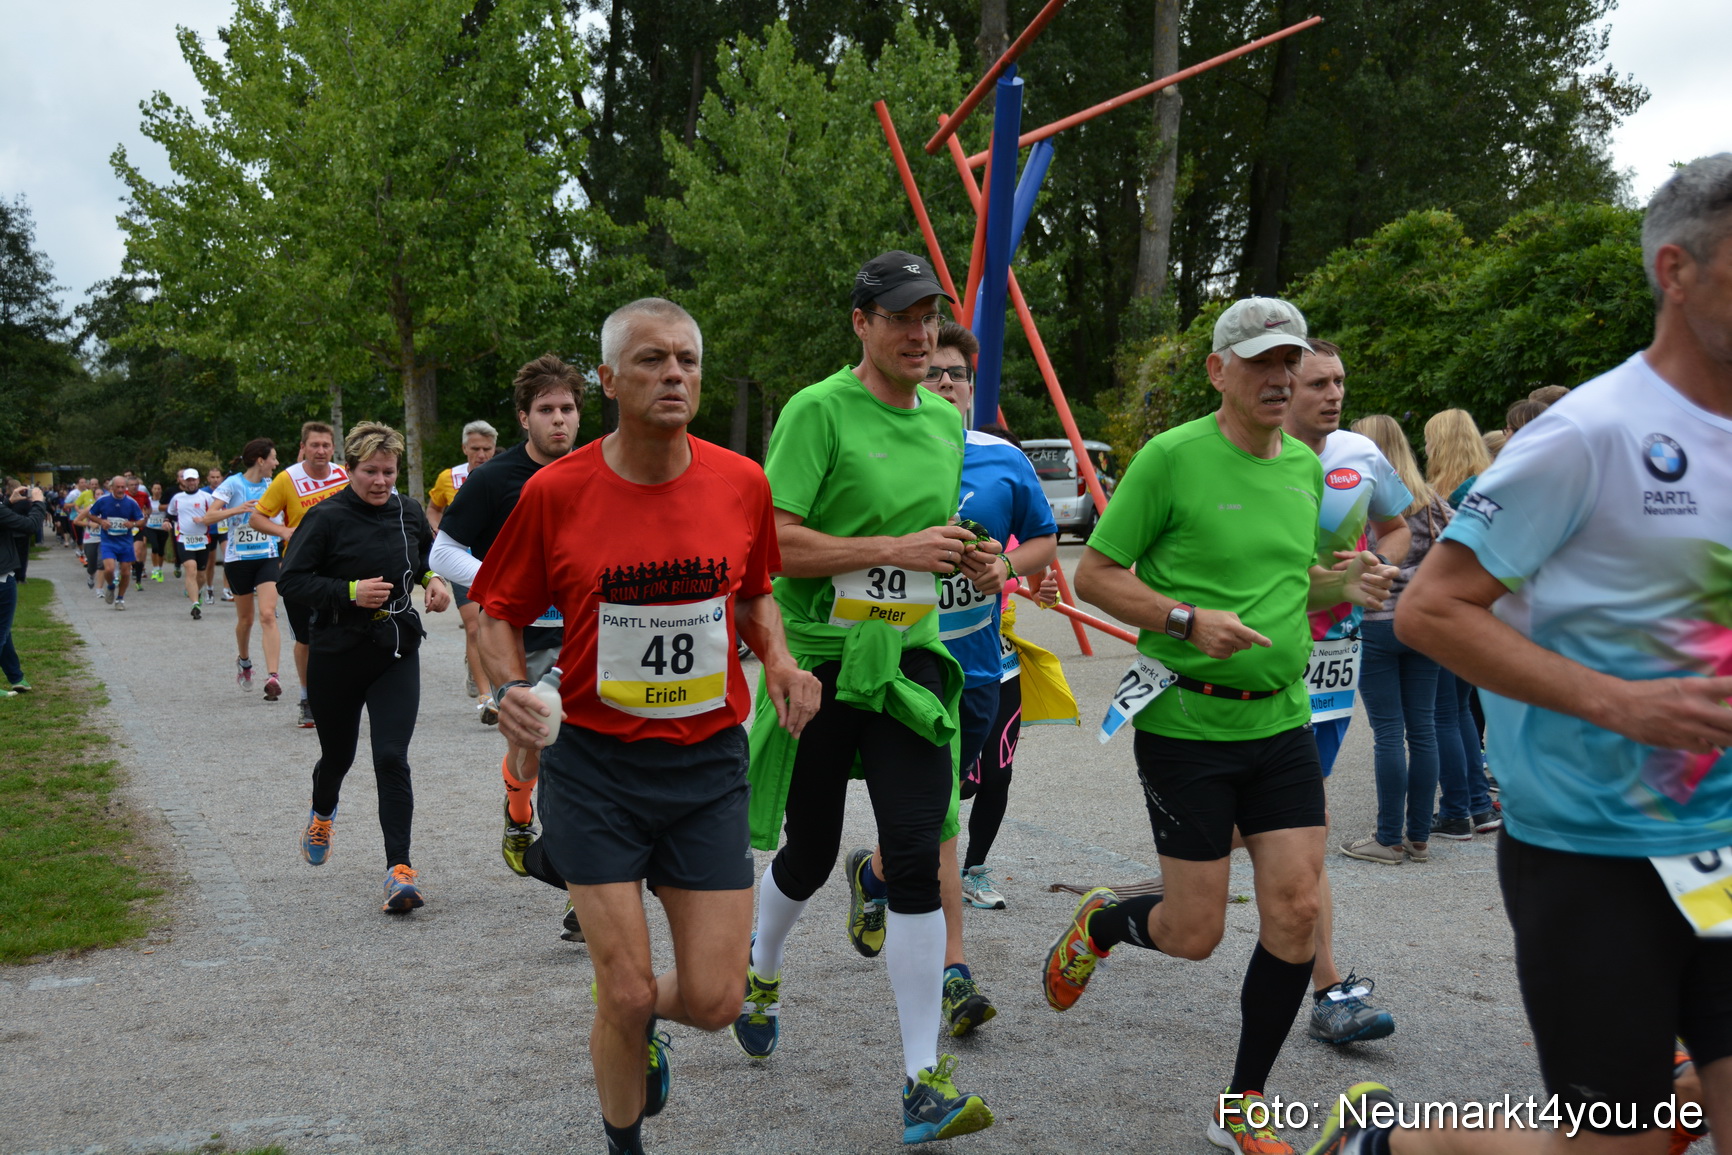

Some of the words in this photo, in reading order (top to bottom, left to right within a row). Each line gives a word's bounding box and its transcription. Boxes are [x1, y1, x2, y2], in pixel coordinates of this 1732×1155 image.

[1329, 473, 1359, 485] Hervis
[1643, 491, 1697, 505] PARTL
[1643, 505, 1699, 516] Neumarkt
[609, 586, 639, 602] RUN
[642, 581, 668, 600] FOR
[671, 577, 714, 595] BÜRNI
[865, 567, 907, 600] 39
[602, 614, 647, 629] PARTL
[649, 614, 710, 629] Neumarkt
[868, 605, 906, 623] Peter
[640, 632, 695, 676] 48
[1318, 646, 1350, 657] Neumarkt
[645, 686, 687, 704] Erich
[1310, 695, 1335, 711] Albert
